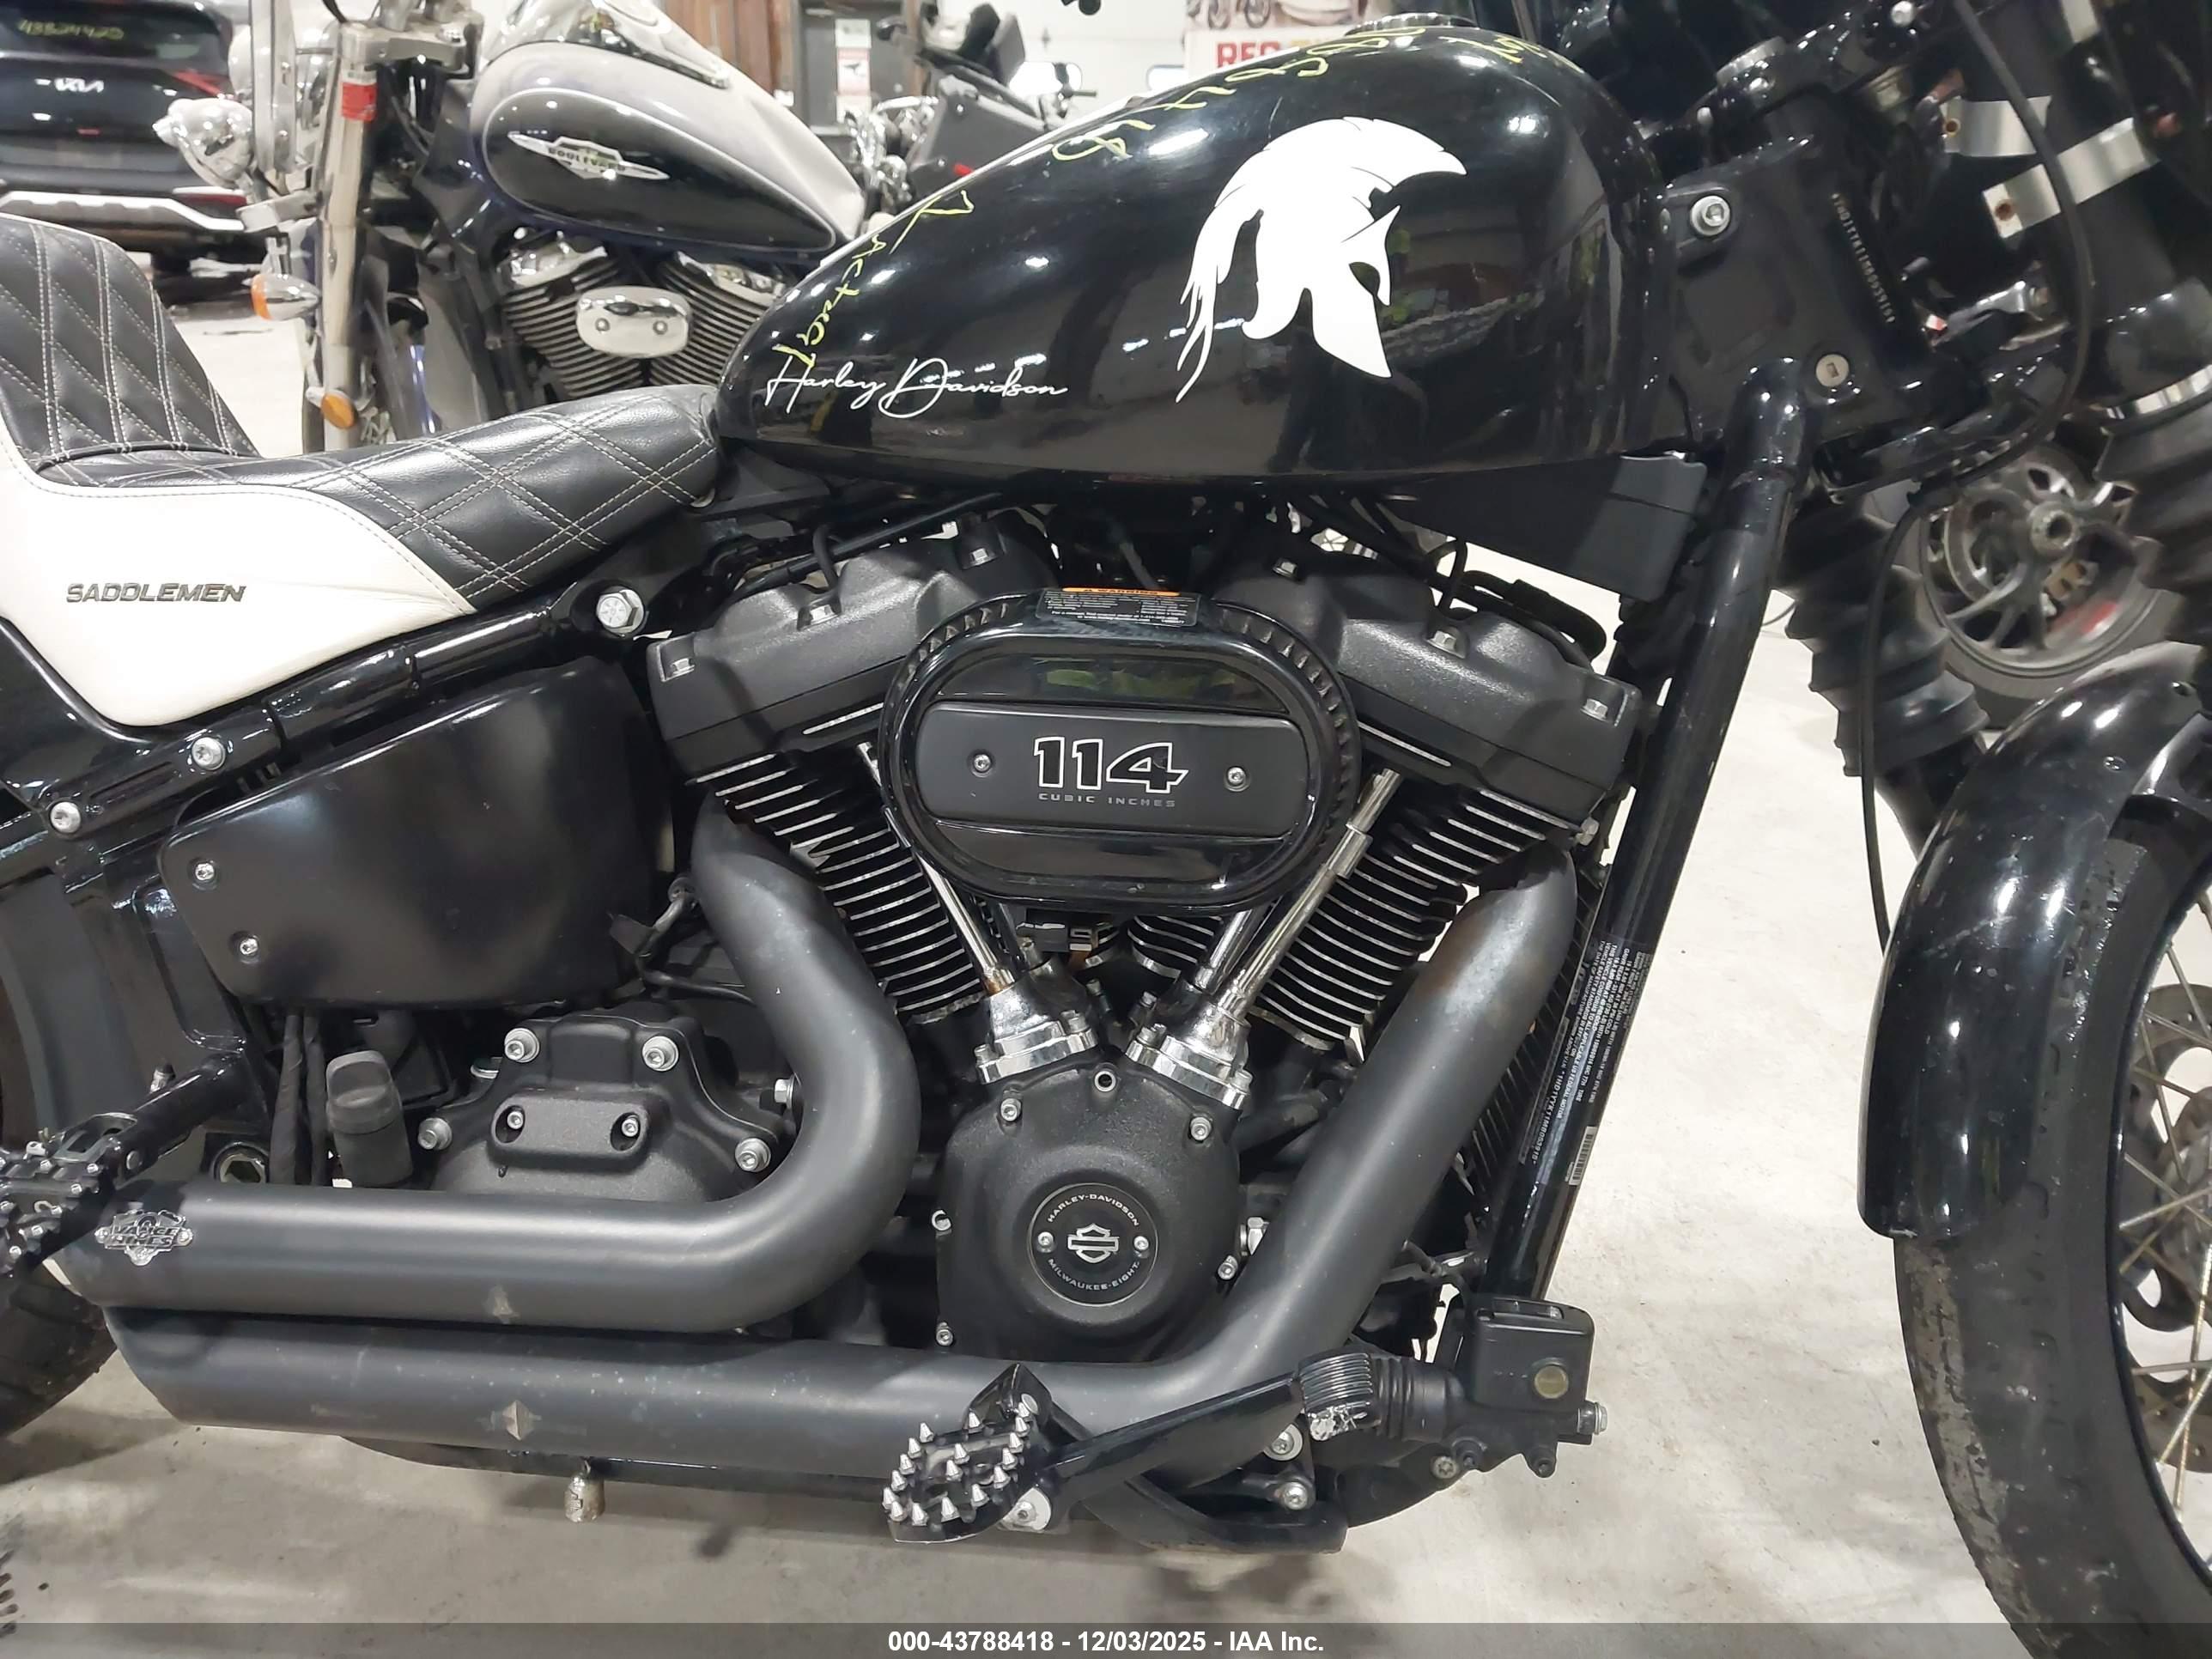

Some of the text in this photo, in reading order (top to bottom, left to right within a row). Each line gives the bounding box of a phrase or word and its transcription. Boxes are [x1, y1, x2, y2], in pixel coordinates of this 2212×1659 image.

[764, 355, 1068, 418] Harley Davidson
[66, 582, 246, 603] SADDLEMEN
[1034, 736, 1189, 793] 114
[1038, 792, 1176, 808] CUBIC INCHES
[1047, 1194, 1140, 1227] HARLEY-DAVIDSON
[1048, 1257, 1140, 1291] MILWAUKEE-EIGHT
